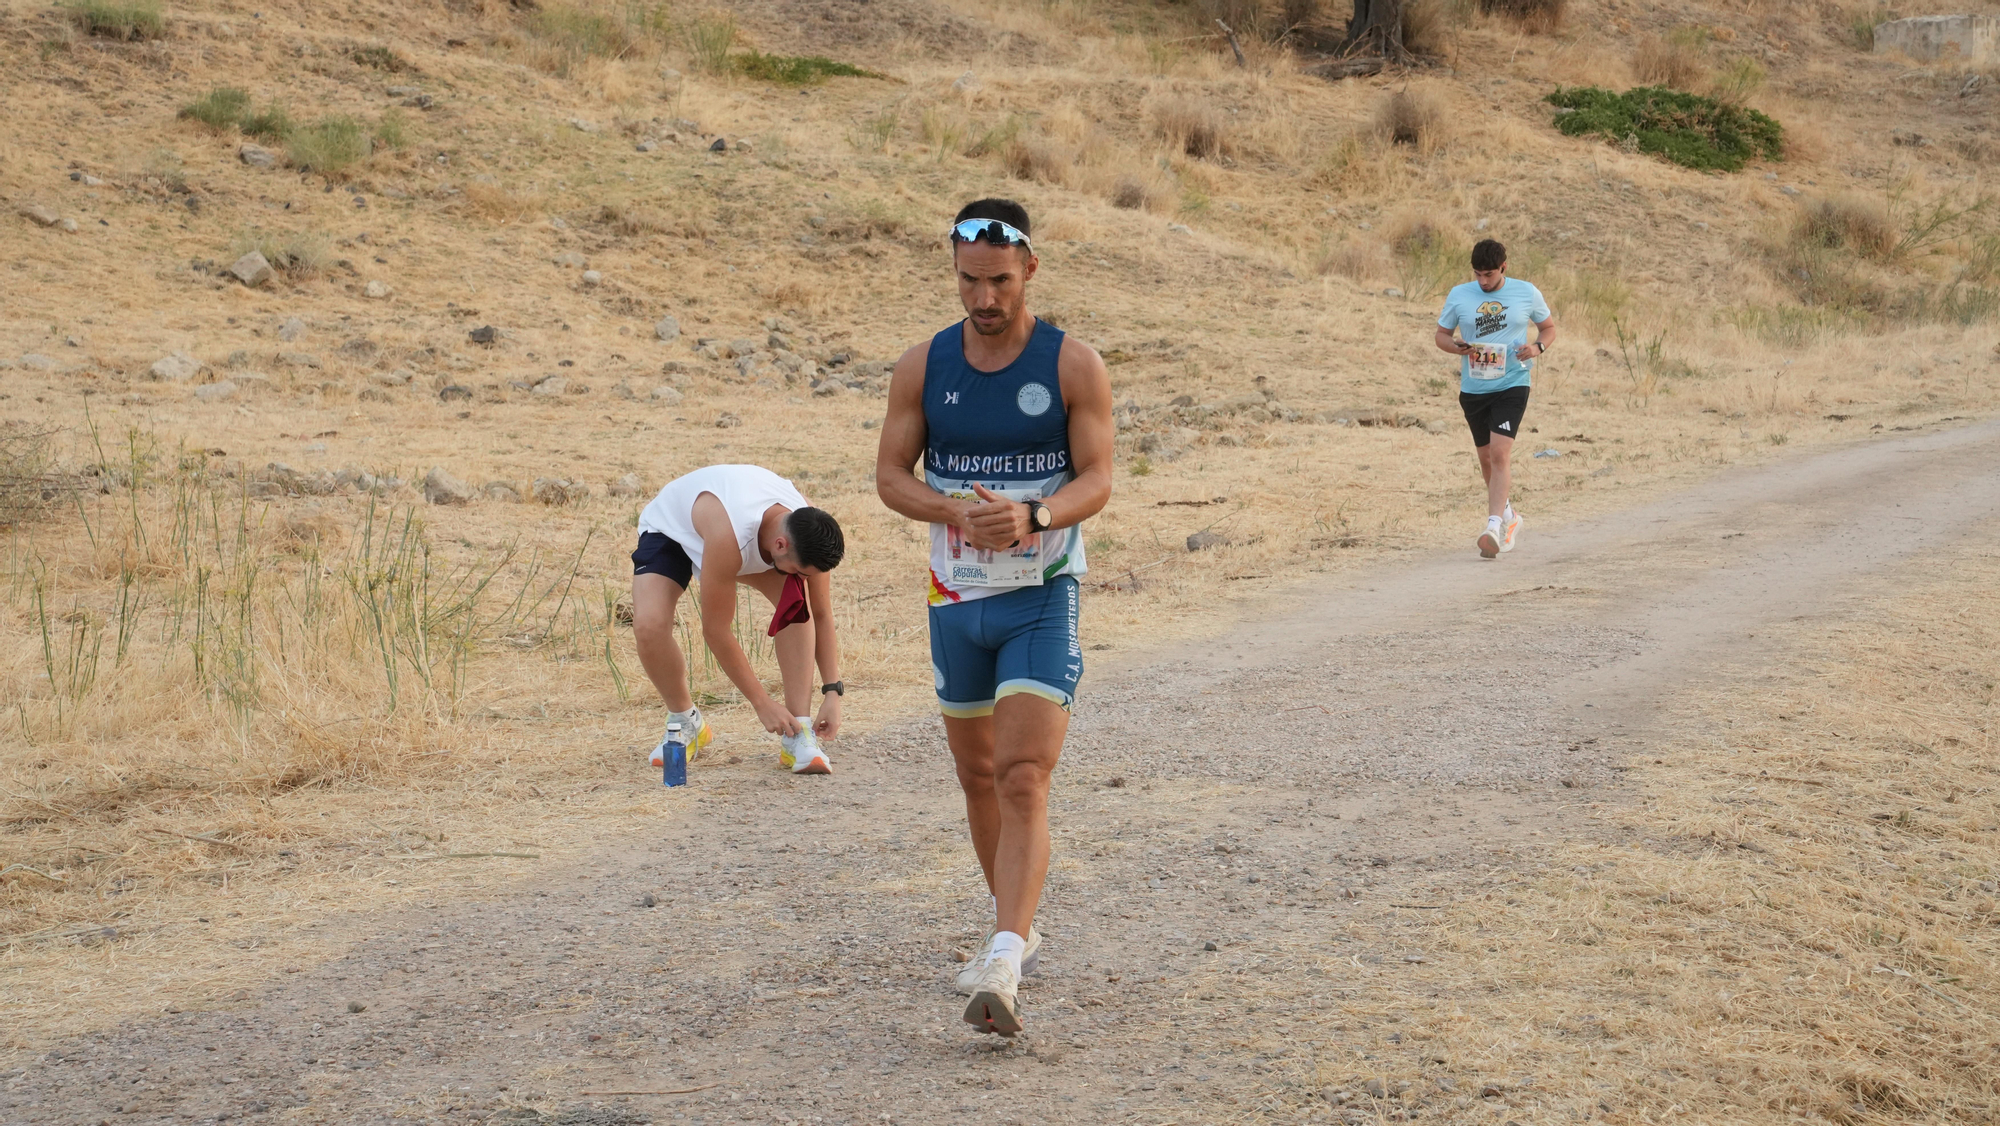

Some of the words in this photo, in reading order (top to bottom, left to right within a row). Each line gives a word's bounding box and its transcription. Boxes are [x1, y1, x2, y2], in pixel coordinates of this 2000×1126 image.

[1475, 352, 1497, 364] 211
[928, 447, 944, 469] C.A.
[947, 450, 1066, 474] MOSQUETEROS
[1067, 585, 1080, 658] MOSQUETEROS
[1065, 662, 1080, 683] C.A.
